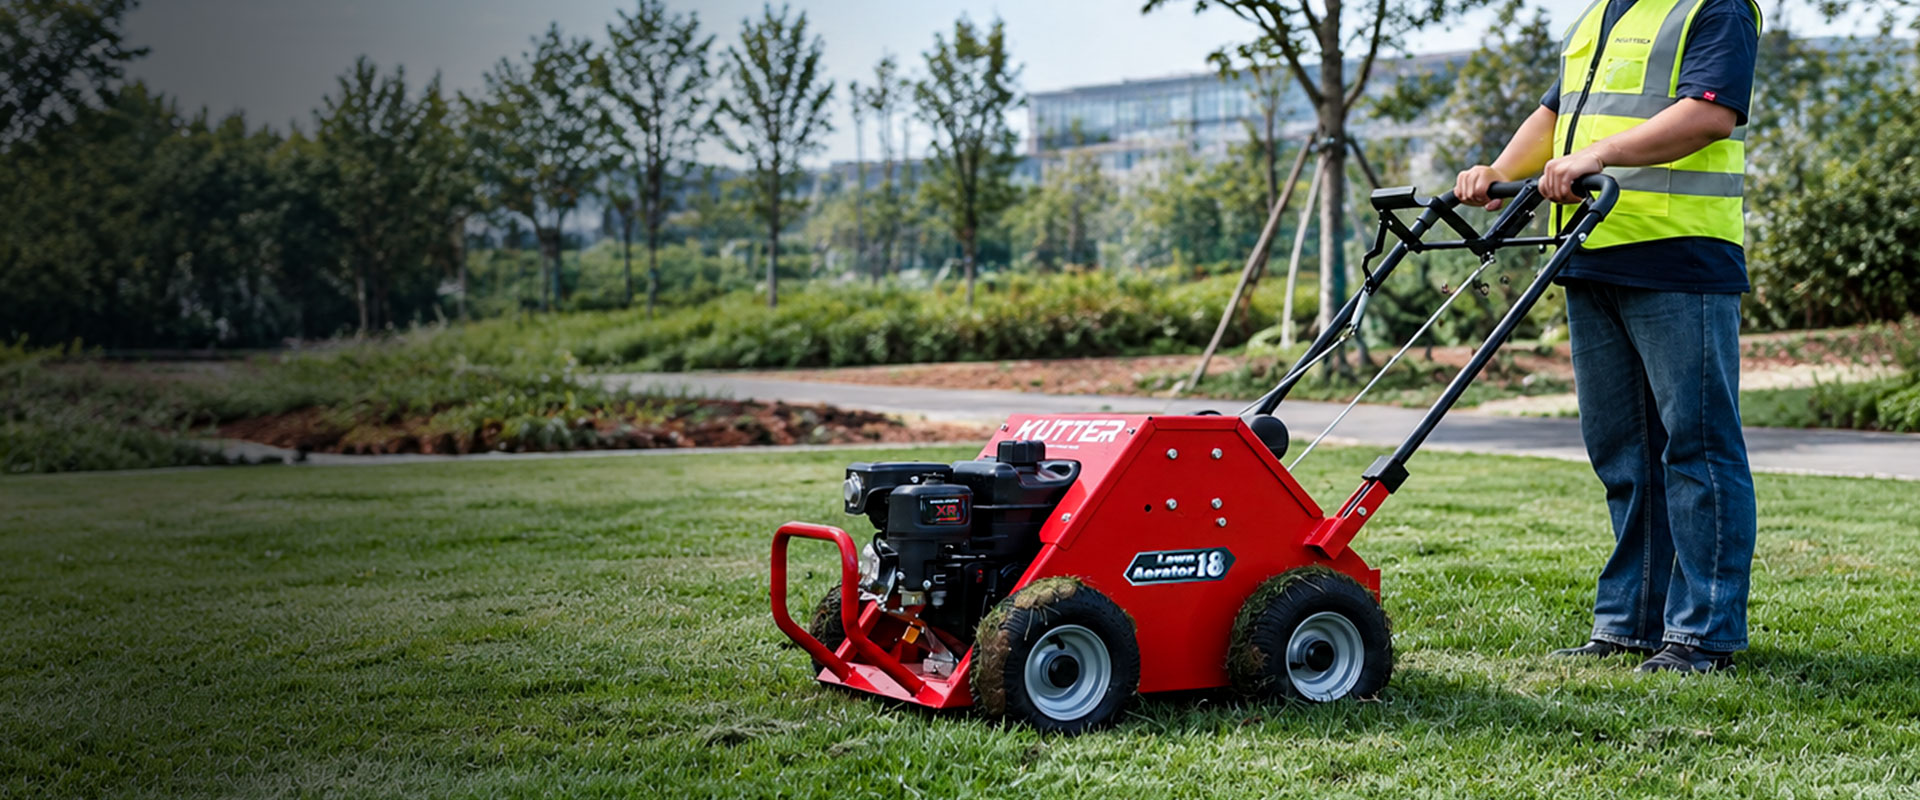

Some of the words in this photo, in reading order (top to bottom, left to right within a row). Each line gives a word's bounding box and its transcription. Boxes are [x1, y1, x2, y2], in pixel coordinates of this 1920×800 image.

[1013, 419, 1126, 442] KUTTER
[936, 504, 957, 516] XR
[1132, 565, 1196, 579] Aerator
[1197, 551, 1225, 577] 18
[1157, 553, 1195, 564] Lawn
